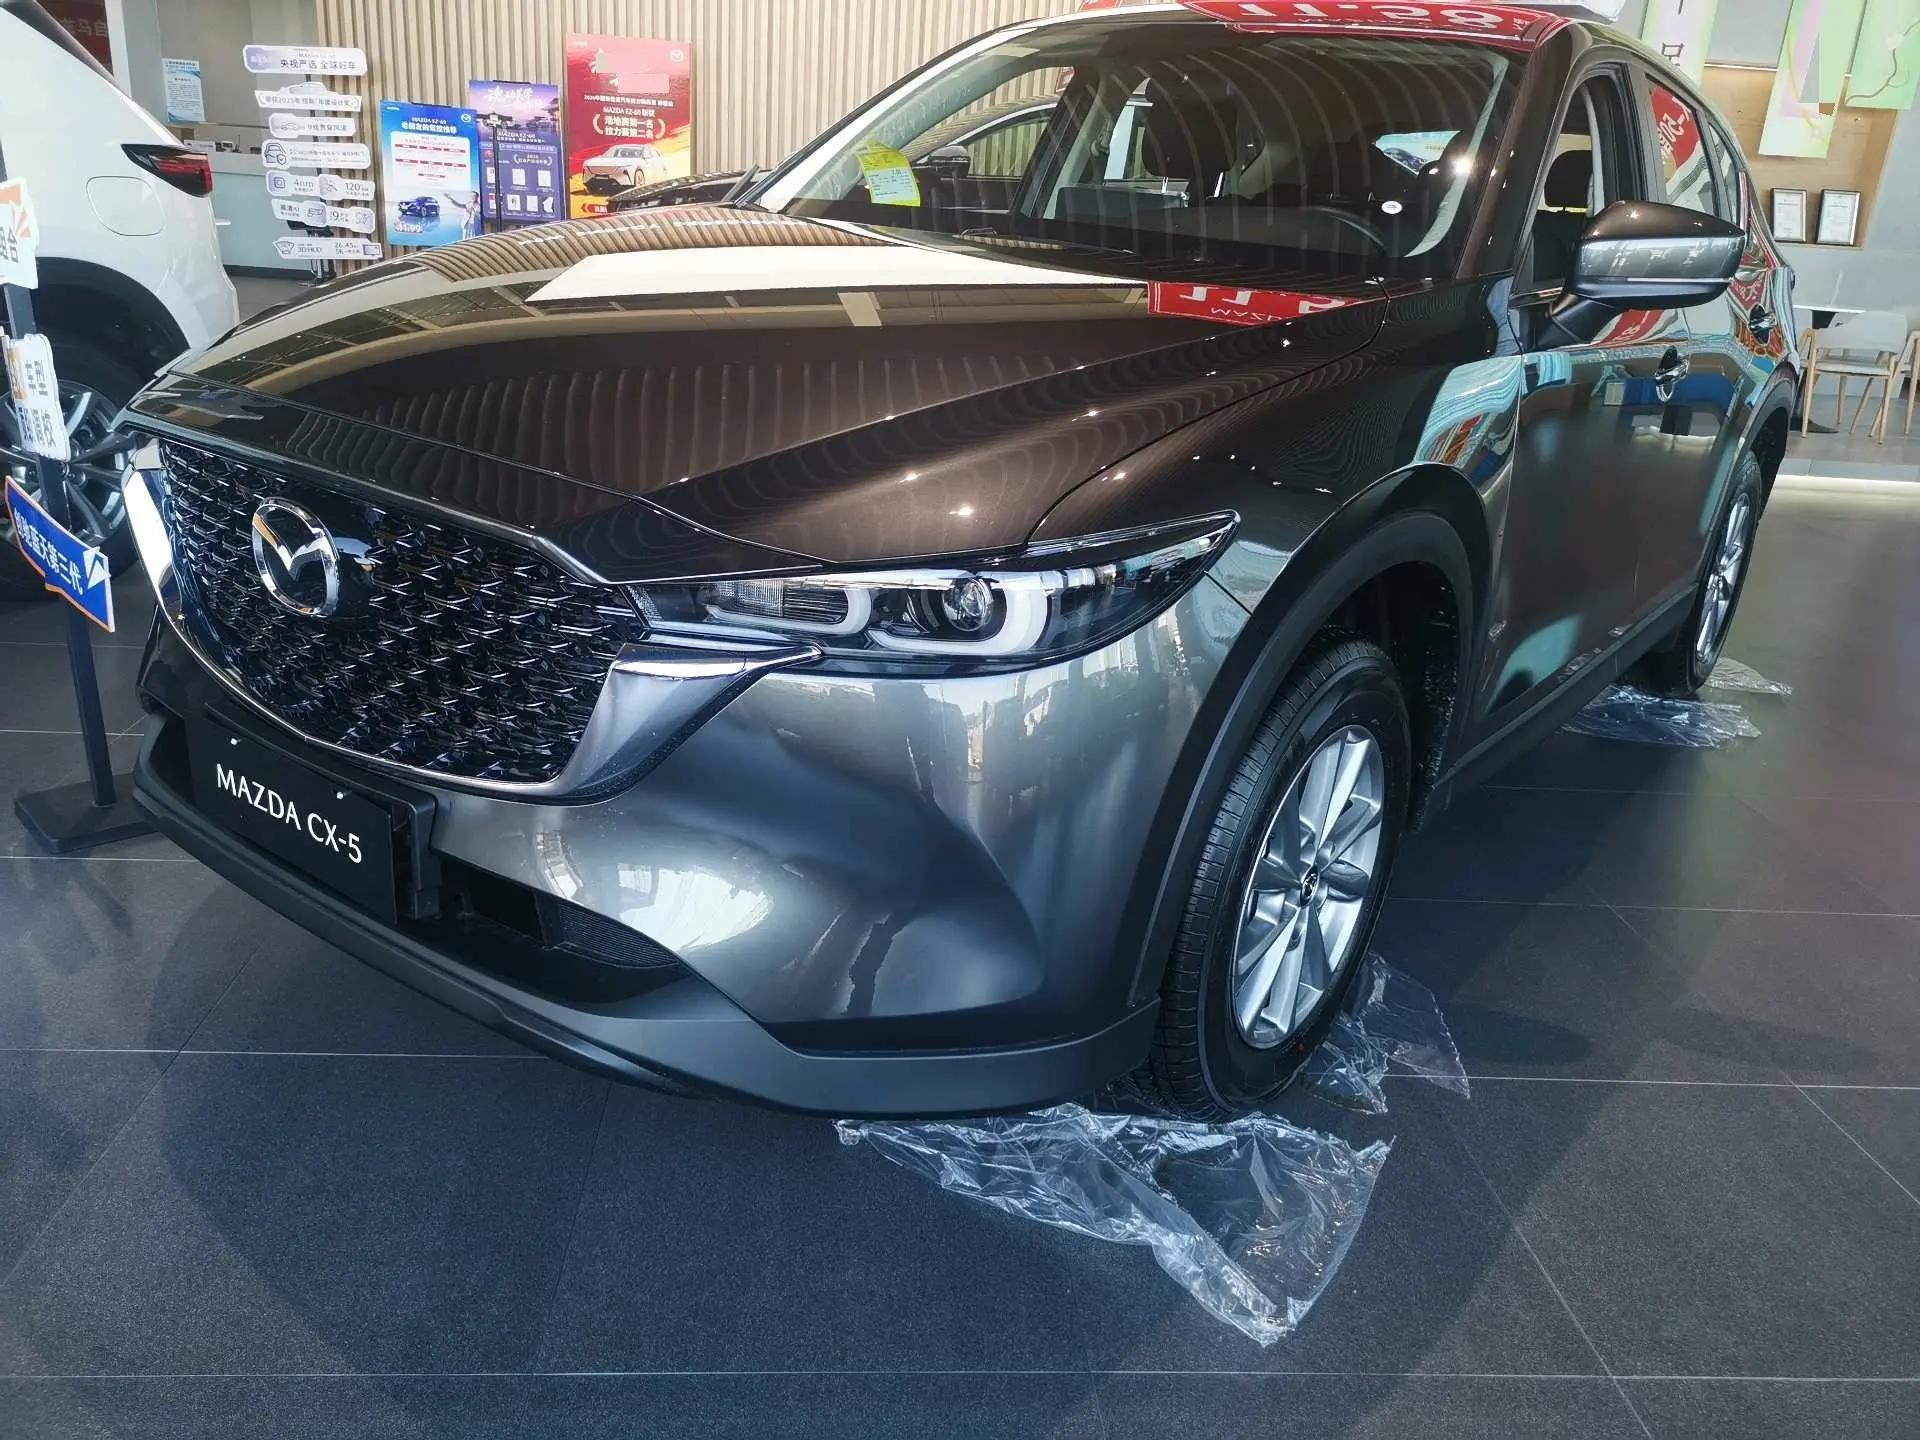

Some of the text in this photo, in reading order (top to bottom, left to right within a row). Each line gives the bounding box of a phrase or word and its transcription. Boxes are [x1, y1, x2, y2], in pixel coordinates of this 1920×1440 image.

[603, 106, 624, 114] MAZDA
[216, 763, 362, 864] MAZDA CX-5
